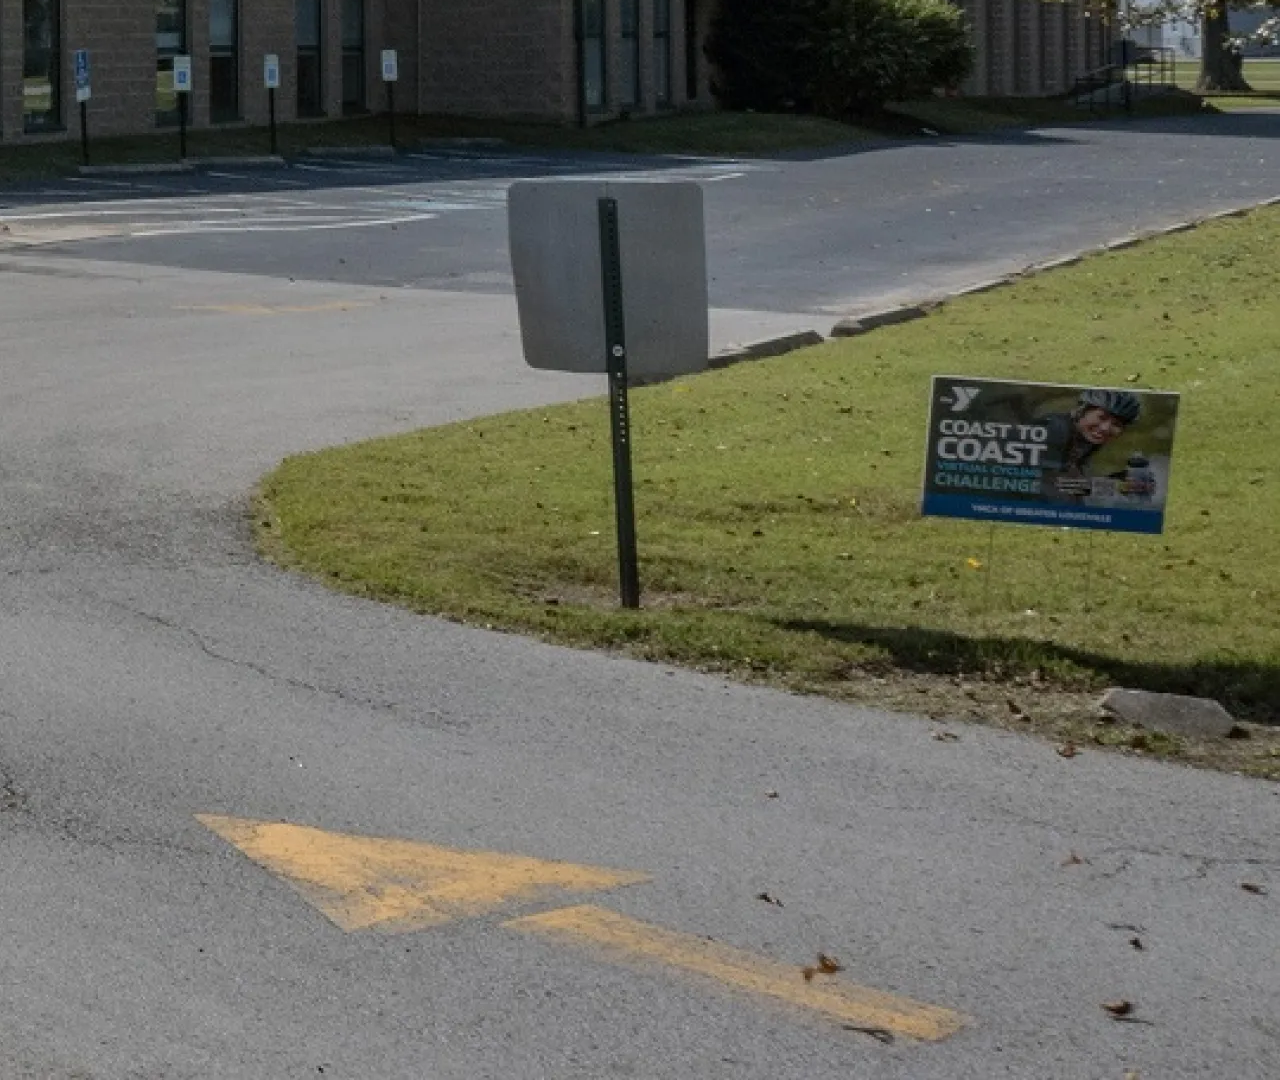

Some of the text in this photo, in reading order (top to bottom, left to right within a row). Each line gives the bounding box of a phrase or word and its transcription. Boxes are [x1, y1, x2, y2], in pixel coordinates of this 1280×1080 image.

[939, 419, 1048, 442] COAST TO
[937, 437, 1048, 466] COAST
[936, 459, 1043, 478] VIRTUAL CYCLING
[934, 472, 1042, 494] CHALLENGE
